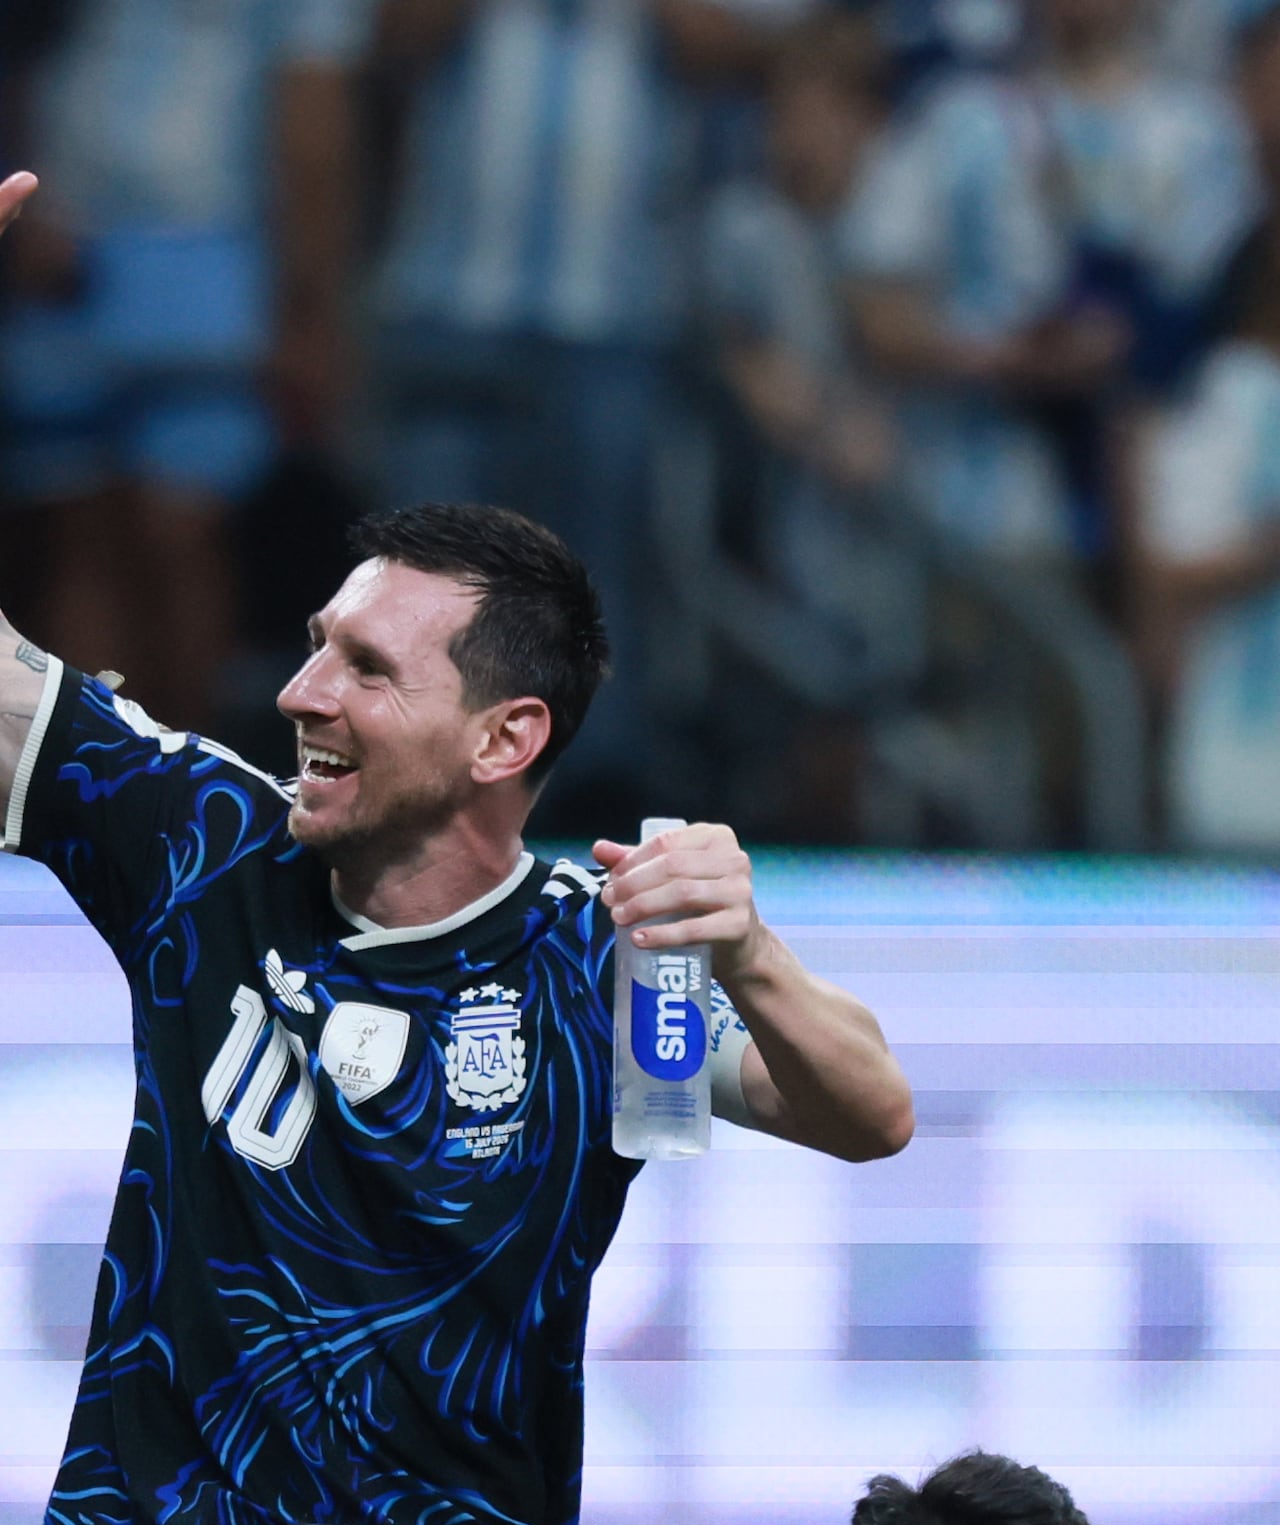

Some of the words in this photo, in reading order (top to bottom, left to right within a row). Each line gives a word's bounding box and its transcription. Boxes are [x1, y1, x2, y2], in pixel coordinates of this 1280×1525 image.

[462, 1033, 508, 1079] AFA
[201, 983, 319, 1171] 10
[338, 1062, 371, 1079] FIFA
[342, 1081, 362, 1092] 2022
[446, 1127, 480, 1139] ENGLAND
[481, 1125, 491, 1137] VS
[474, 1138, 491, 1148] JULY
